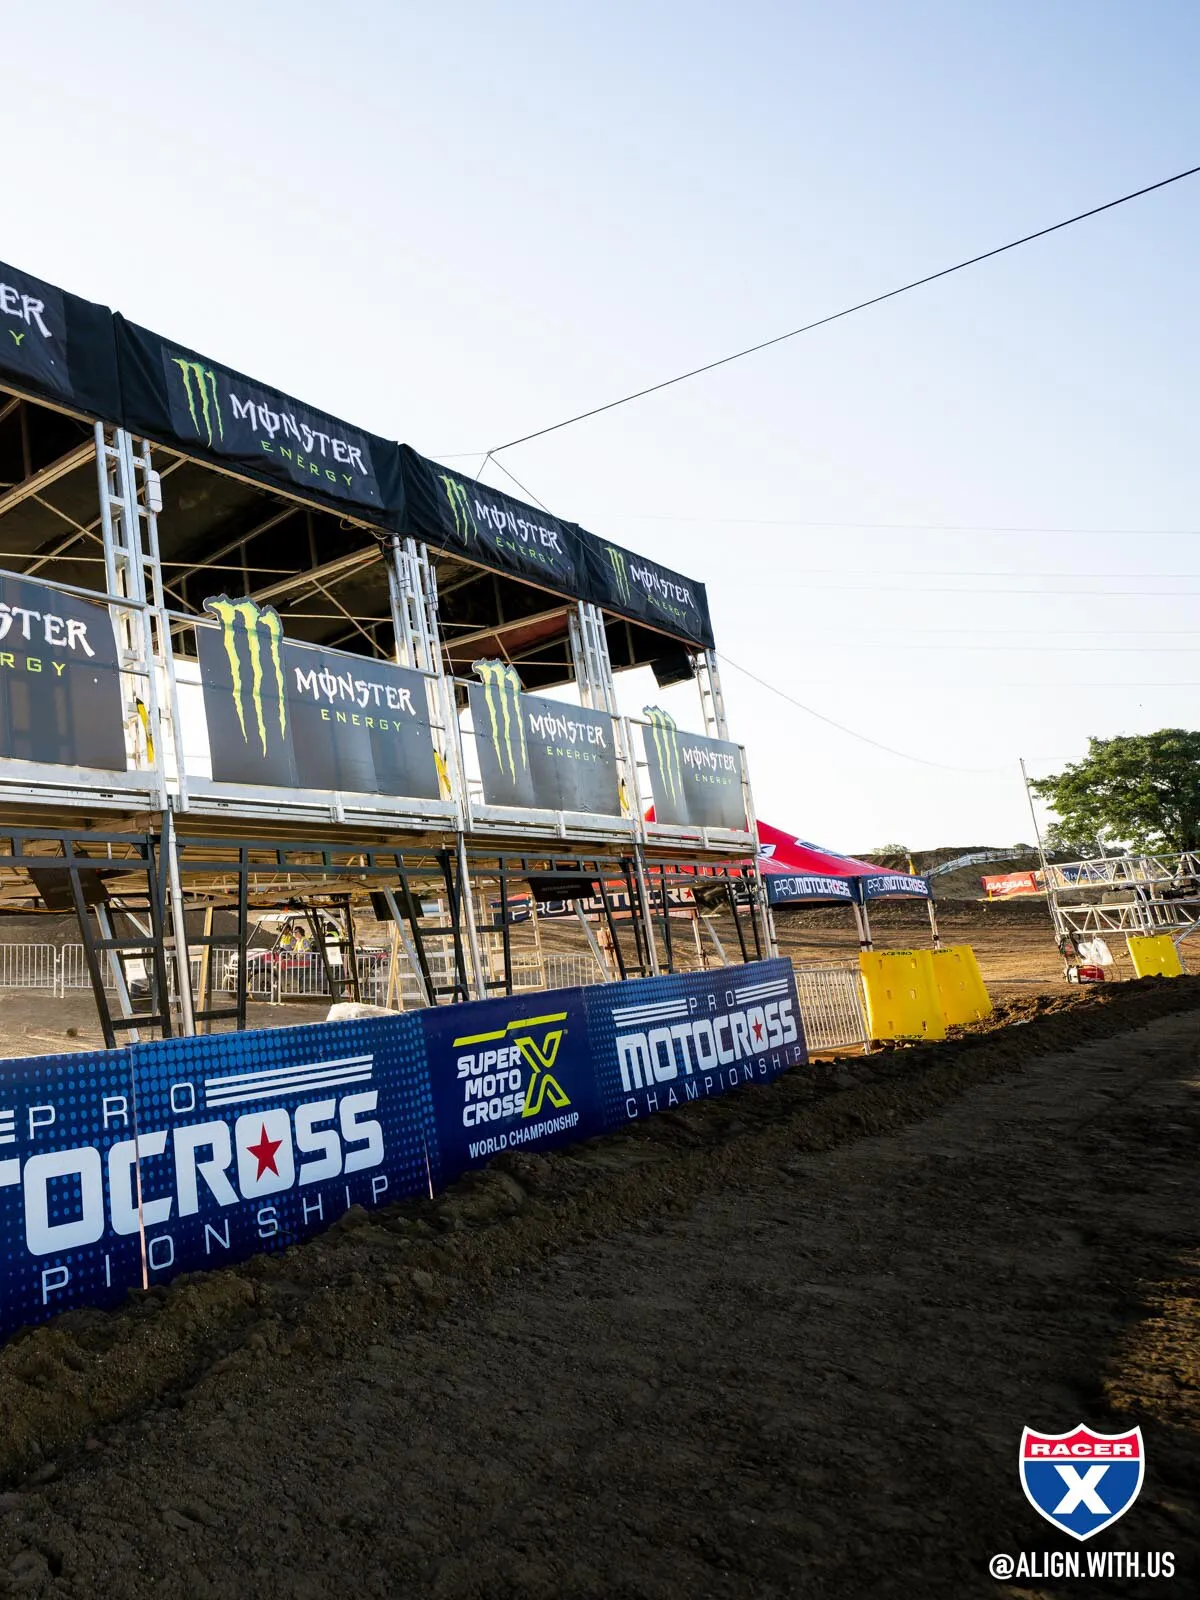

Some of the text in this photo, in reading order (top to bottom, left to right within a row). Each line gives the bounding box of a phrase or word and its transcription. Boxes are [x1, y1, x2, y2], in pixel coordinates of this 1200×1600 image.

[229, 393, 368, 475] MONSTER
[261, 440, 353, 486] ENERGY
[474, 500, 562, 554] MONSTER
[495, 536, 554, 565] ENERGY
[630, 564, 694, 609] MONSTER
[294, 667, 416, 716] MONSTER
[320, 708, 402, 732] ENERGY
[528, 712, 606, 749] MONSTER
[547, 746, 598, 763] ENERGY
[682, 745, 736, 774] MONSTER
[695, 773, 733, 785] ENERGY
[986, 879, 1033, 891] GASGAS
[688, 990, 735, 1015] PRO
[457, 1046, 521, 1078] SUPER
[616, 999, 798, 1092] MOTOCROSS
[465, 1069, 522, 1102] MOTO
[626, 1045, 802, 1119] CHAMPIONSHIP
[28, 1082, 196, 1140] PRO
[463, 1091, 526, 1127] CROSS
[469, 1112, 579, 1159] WORLD CHAMPIONSHIP
